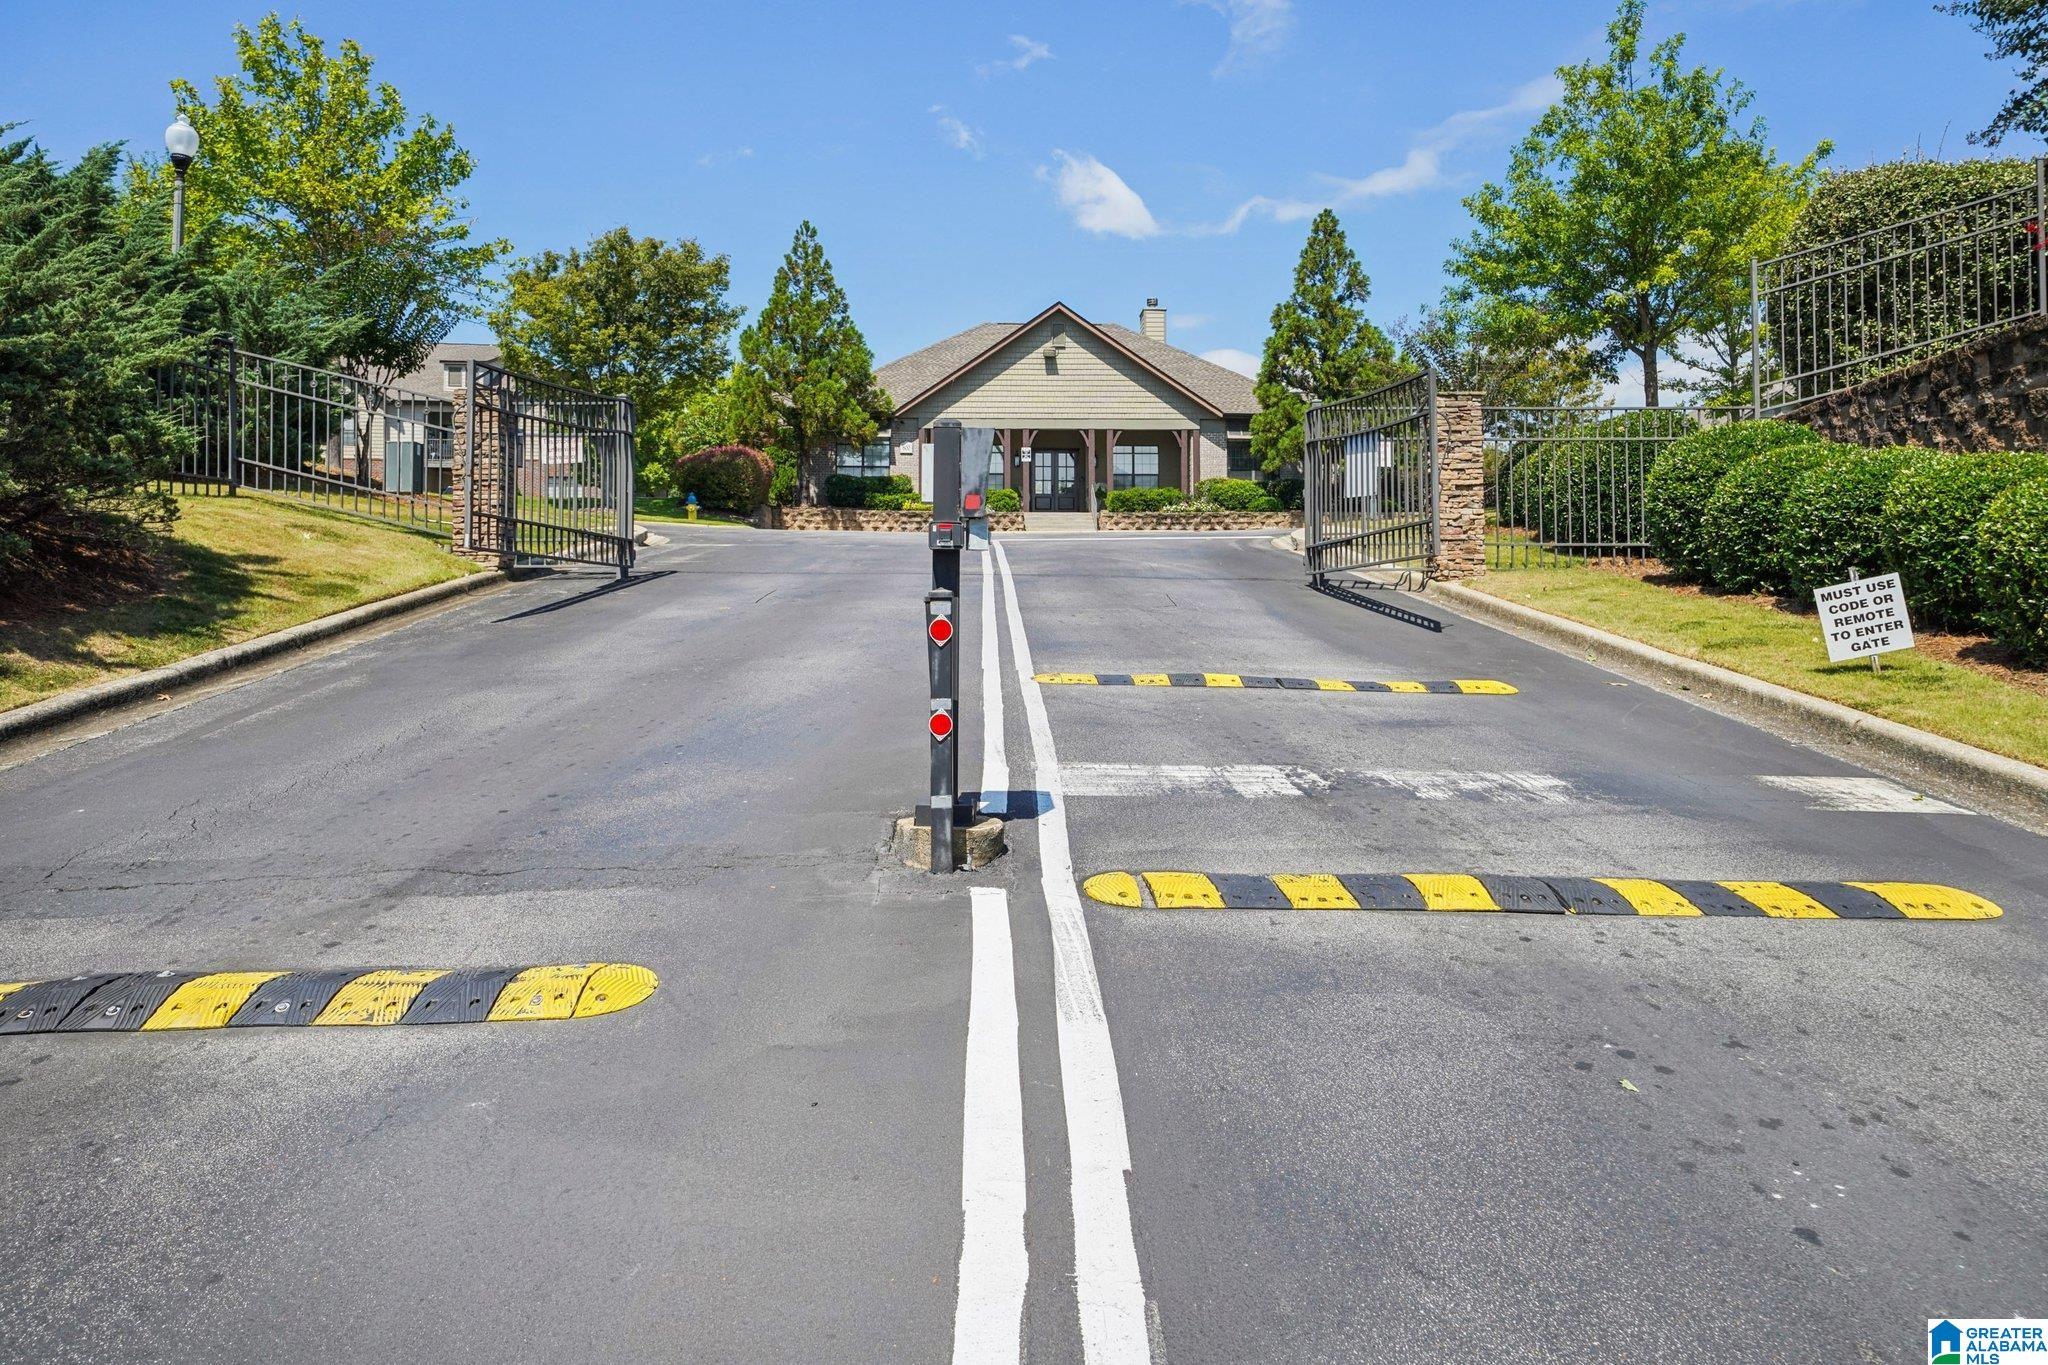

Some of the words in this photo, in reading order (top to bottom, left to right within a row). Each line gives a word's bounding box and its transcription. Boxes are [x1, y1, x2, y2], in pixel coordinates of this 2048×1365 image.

[1820, 586, 1861, 602] MUST
[1866, 579, 1896, 593] USE
[1829, 598, 1869, 614] CODE
[1873, 594, 1894, 606] OR
[1834, 607, 1895, 628] REMOTE
[1831, 630, 1851, 642] TO
[1855, 620, 1904, 637] ENTER
[1851, 636, 1891, 652] GATE
